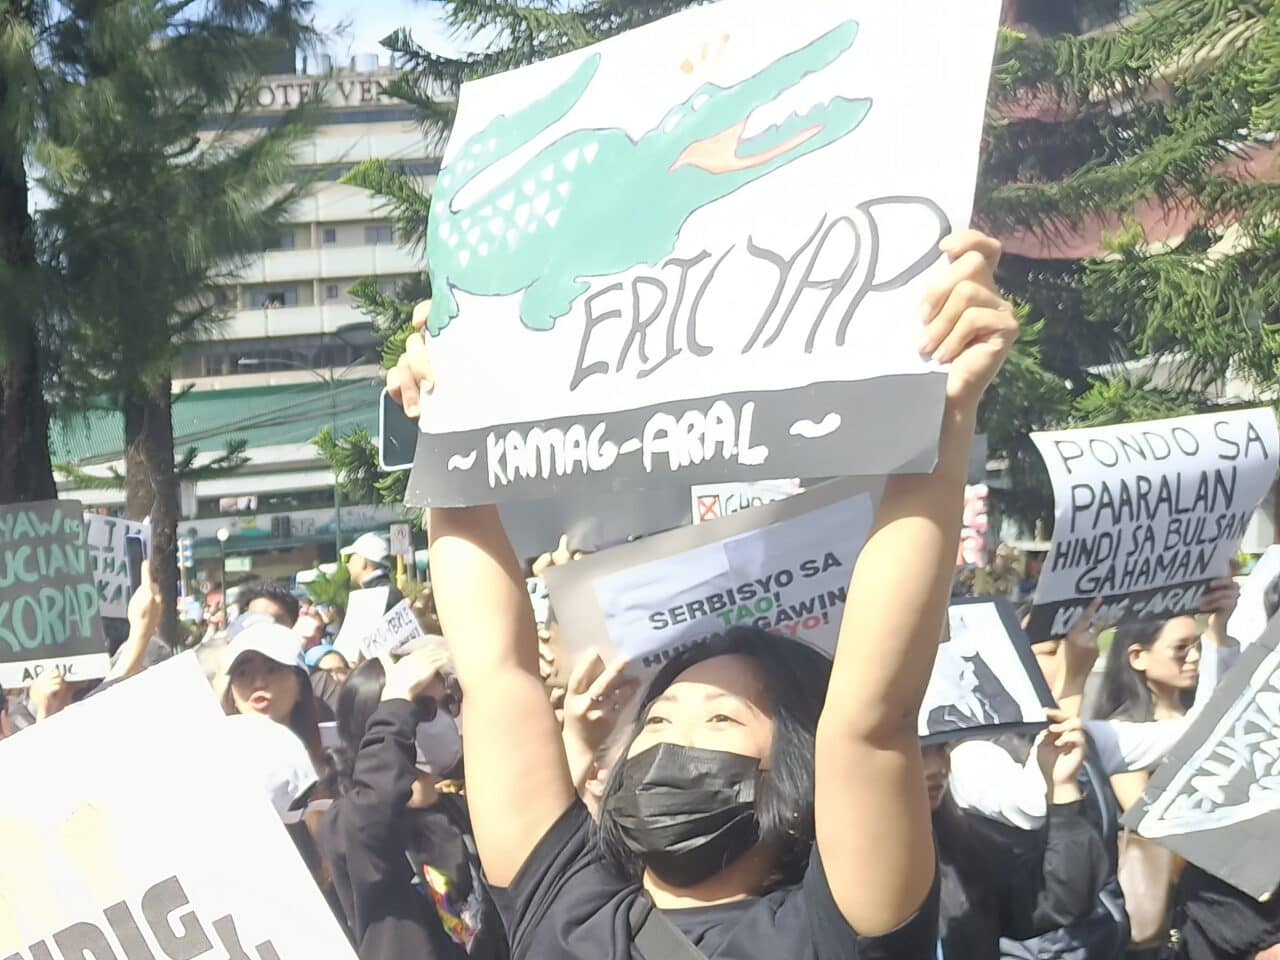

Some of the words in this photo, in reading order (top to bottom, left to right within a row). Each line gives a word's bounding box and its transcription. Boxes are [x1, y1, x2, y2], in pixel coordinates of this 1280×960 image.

[570, 246, 735, 391] ERIC
[741, 195, 951, 355] YAP
[1054, 426, 1200, 474] PONDO
[1215, 420, 1268, 461] SA
[1069, 466, 1238, 532] PAARALAN
[1052, 531, 1122, 572] HINDI
[1126, 523, 1157, 558] SA
[1074, 547, 1217, 596] GAHAMAN
[648, 569, 794, 631] SERBISYO
[799, 551, 843, 579] SA
